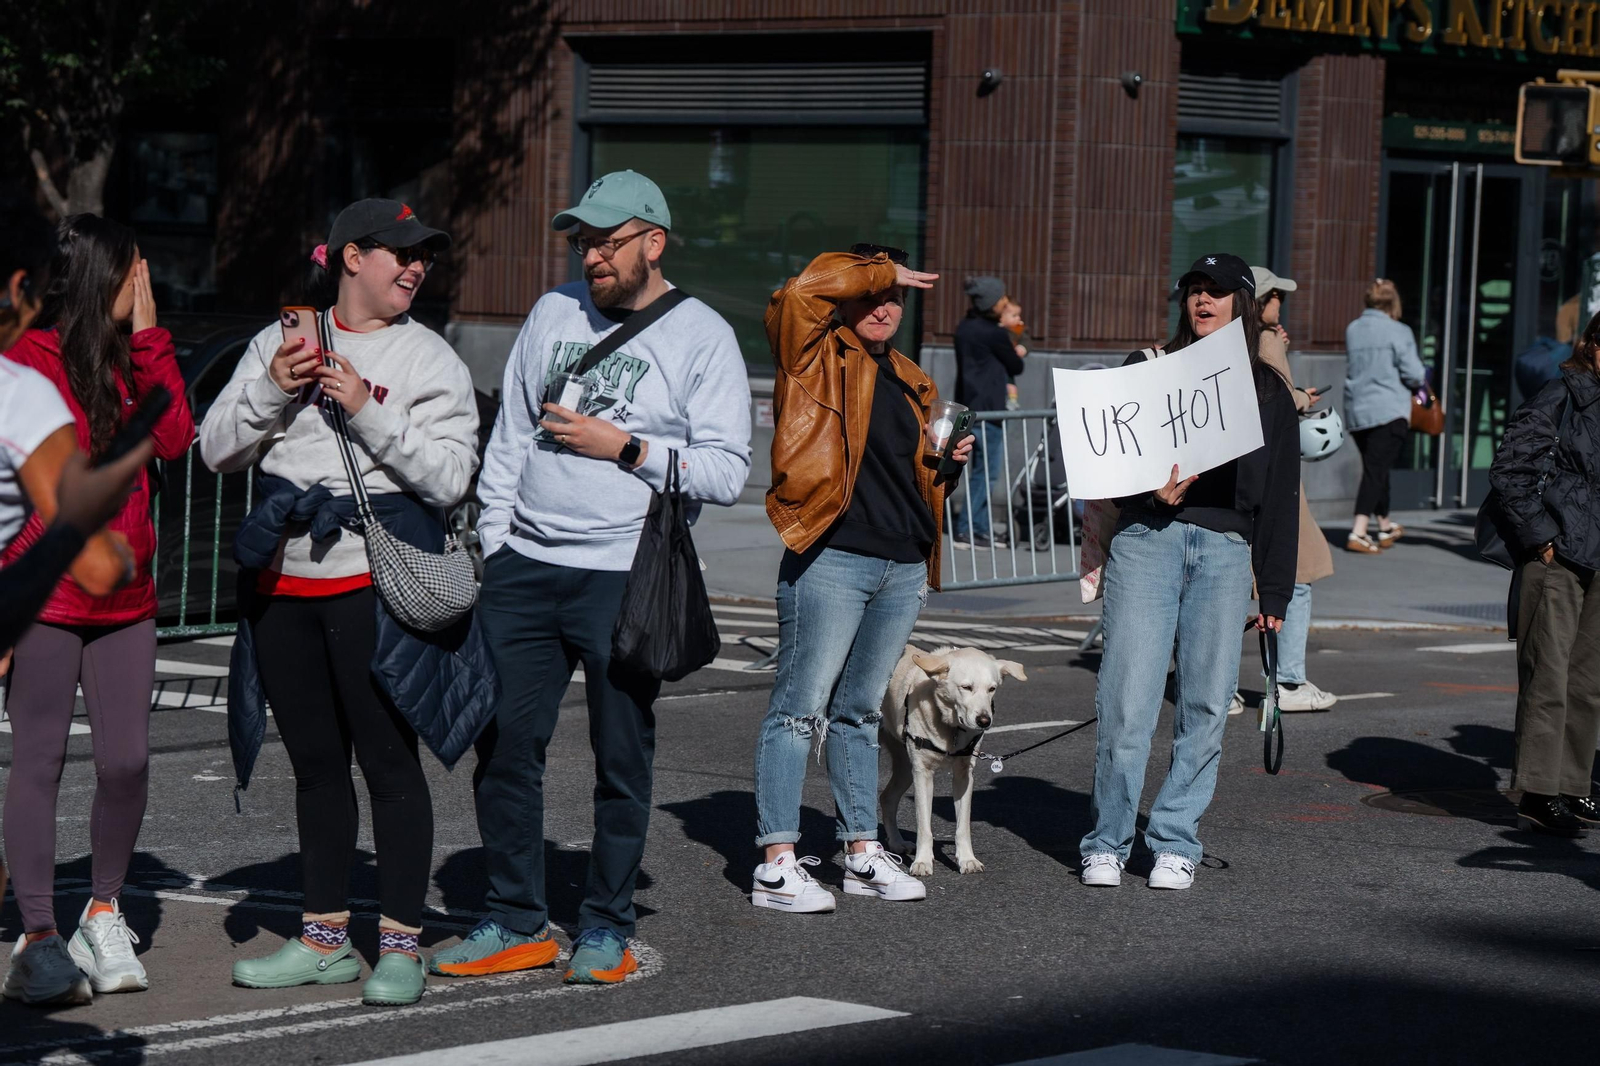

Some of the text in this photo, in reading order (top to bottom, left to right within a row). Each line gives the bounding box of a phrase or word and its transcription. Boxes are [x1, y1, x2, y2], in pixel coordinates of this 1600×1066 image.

[1444, 0, 1600, 58] KITCH
[543, 340, 651, 405] LIBRTY
[613, 408, 629, 420] 24
[1081, 366, 1231, 457] UR HOT
